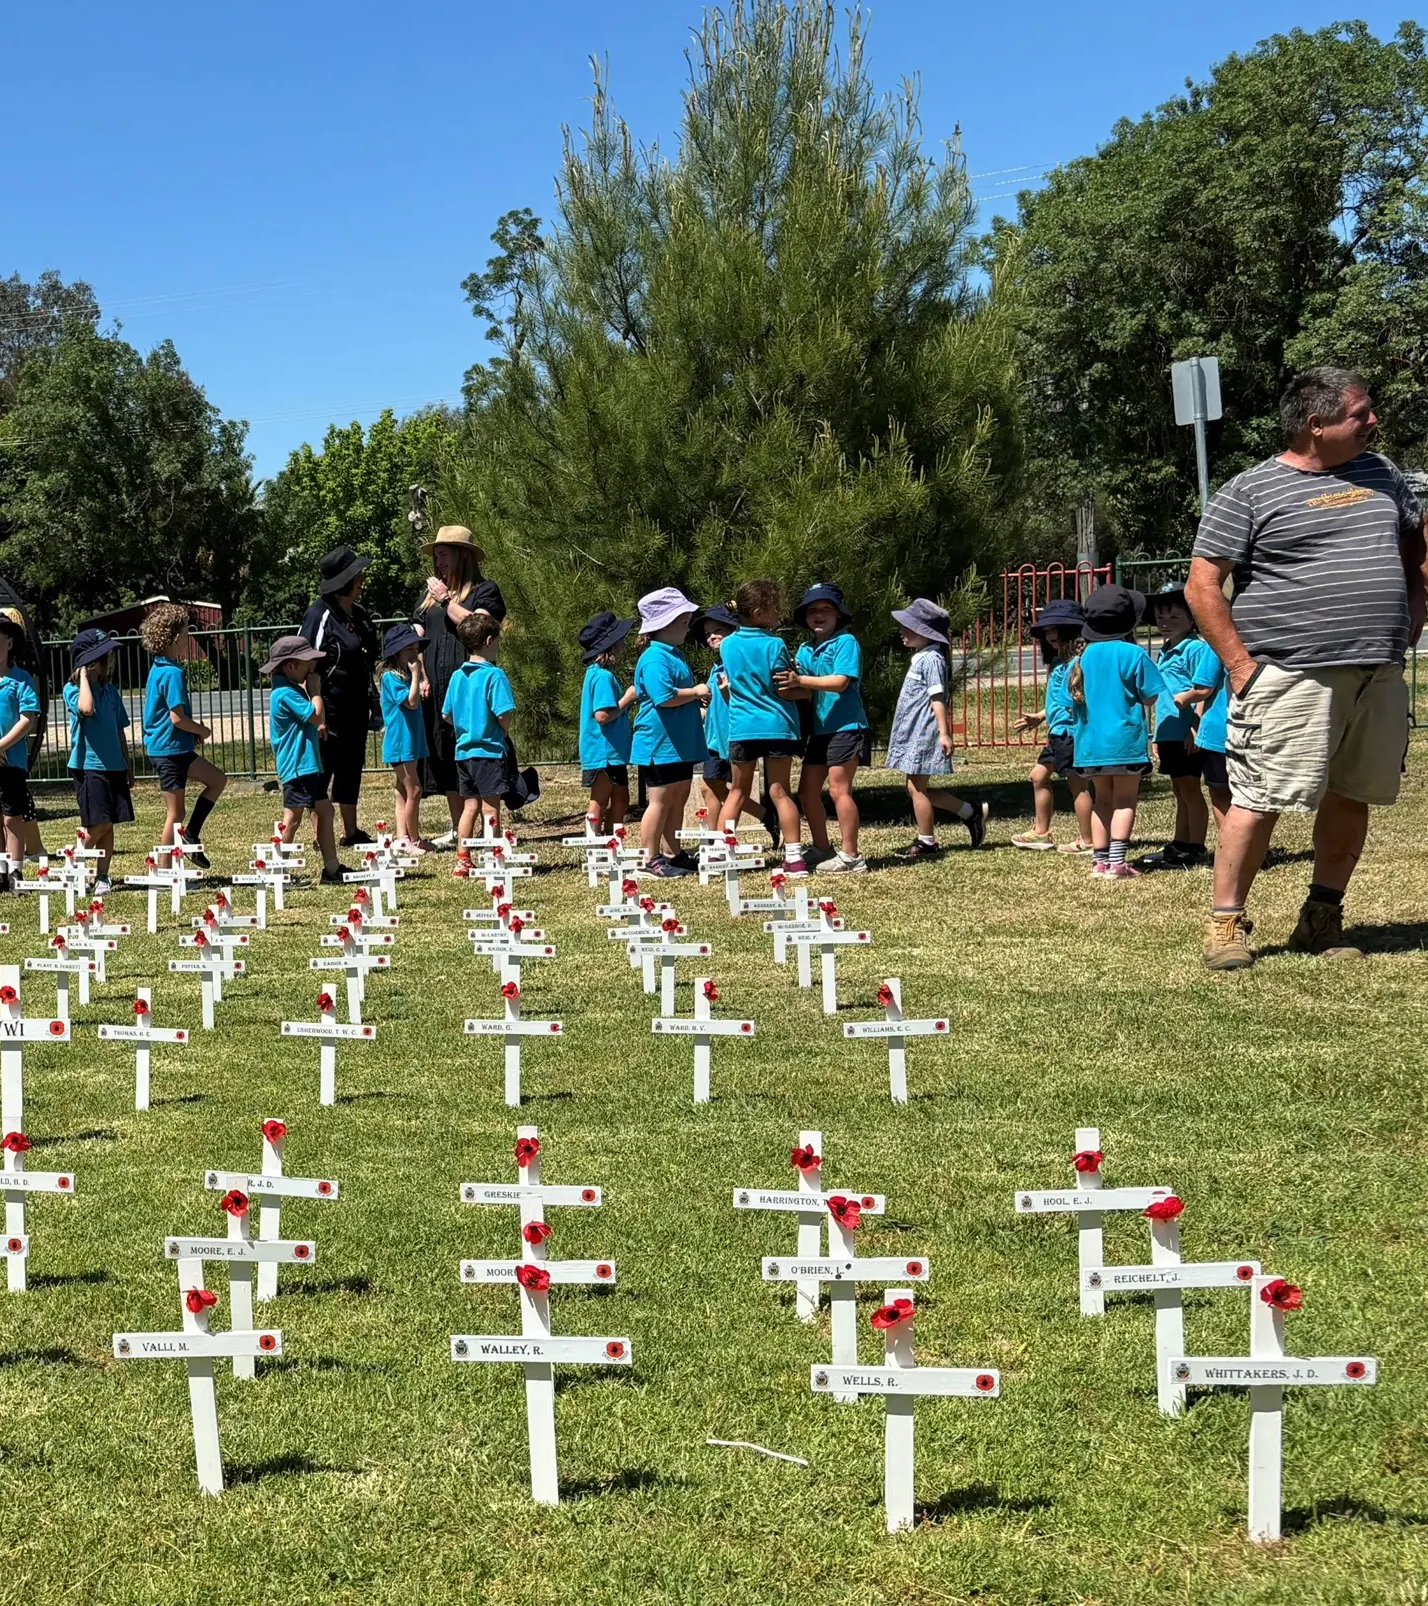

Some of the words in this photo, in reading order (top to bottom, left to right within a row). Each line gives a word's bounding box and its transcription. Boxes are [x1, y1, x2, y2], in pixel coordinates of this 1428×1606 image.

[257, 1179, 265, 1188] J.
[266, 1180, 274, 1188] D.
[484, 1190, 521, 1199] GRESKIE
[759, 1195, 820, 1207] HARRINGTON,
[1043, 1197, 1070, 1206] HOOL,
[1073, 1197, 1082, 1205] E.
[1084, 1197, 1092, 1205] J.
[190, 1246, 225, 1256] MOORE,
[227, 1248, 236, 1256] E.
[238, 1248, 246, 1256] J.
[791, 1265, 834, 1276] O'BRIEN,
[1113, 1273, 1169, 1285] REICHELT,
[1171, 1273, 1181, 1282] J.
[142, 1342, 176, 1352] VALLI,
[178, 1342, 190, 1351] M.
[481, 1343, 530, 1356] WALLEY,
[533, 1345, 544, 1355] R.
[1204, 1368, 1290, 1380] WHITTAKERS,
[1292, 1369, 1303, 1379] J.
[1307, 1369, 1319, 1379] D.
[842, 1375, 884, 1388] WELLS,
[887, 1376, 899, 1388] R.
